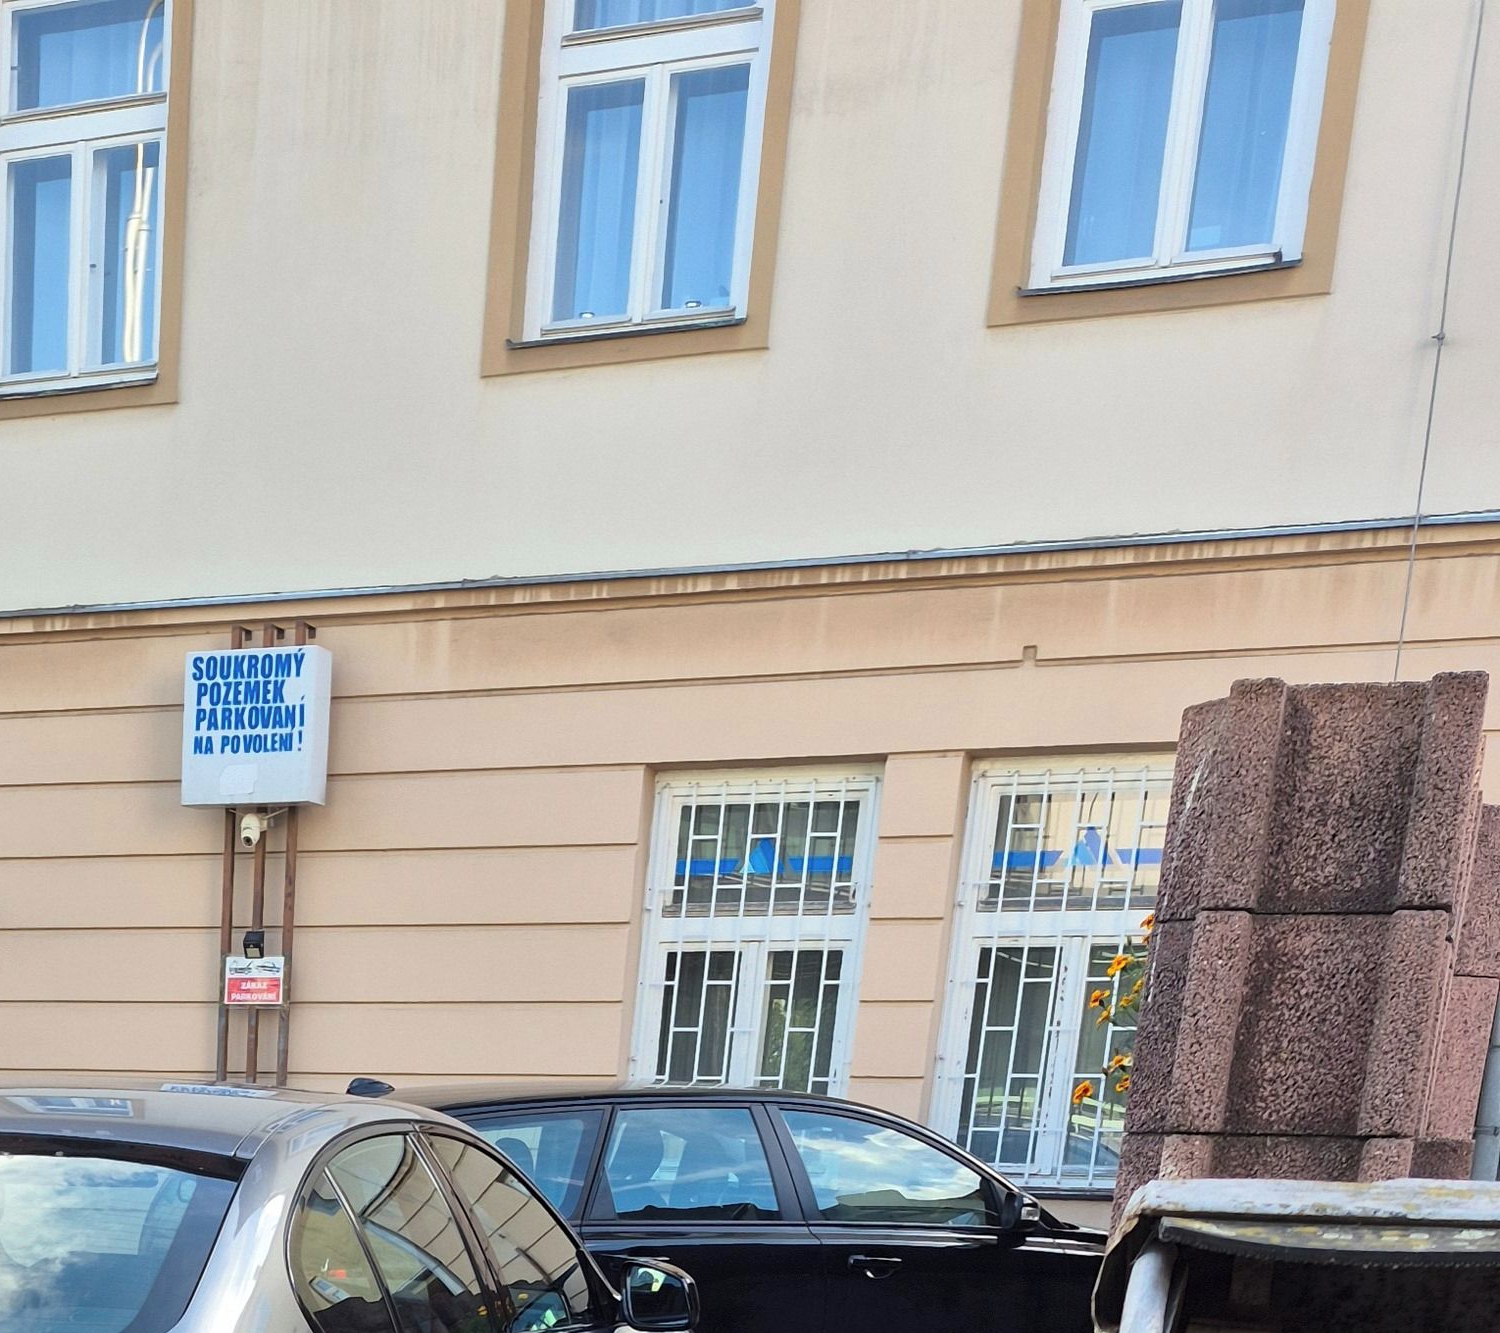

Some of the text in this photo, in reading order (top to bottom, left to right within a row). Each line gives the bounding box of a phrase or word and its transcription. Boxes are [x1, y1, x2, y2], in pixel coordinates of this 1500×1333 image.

[192, 648, 306, 681] SOUKROMÝ
[196, 679, 286, 706] POZEMEK
[193, 736, 214, 755] NA
